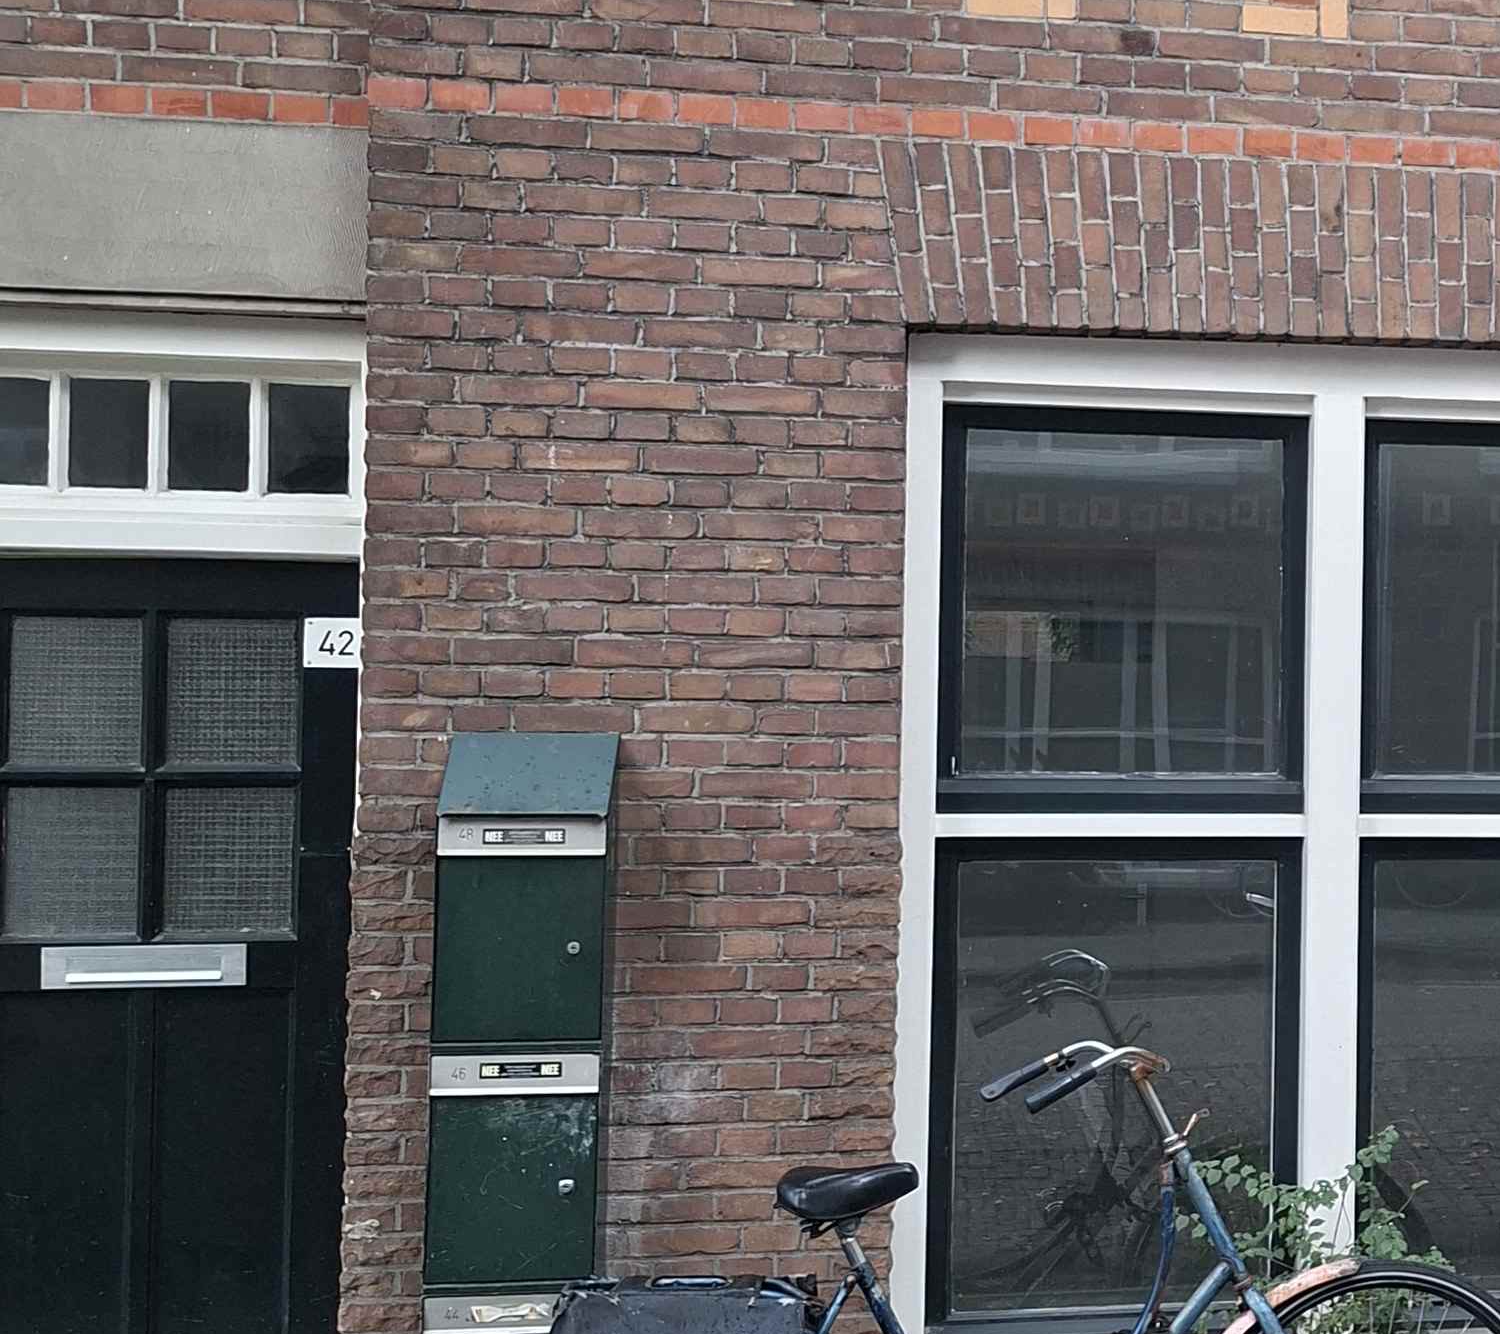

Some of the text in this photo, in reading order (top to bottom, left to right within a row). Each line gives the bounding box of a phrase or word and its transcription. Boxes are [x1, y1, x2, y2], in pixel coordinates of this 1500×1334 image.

[318, 630, 354, 656] 42
[459, 828, 473, 841] 48
[485, 831, 504, 843] NEE
[545, 831, 564, 842] NEE
[451, 1067, 467, 1081] 46
[482, 1065, 500, 1076] NEE
[541, 1064, 560, 1075] NEE
